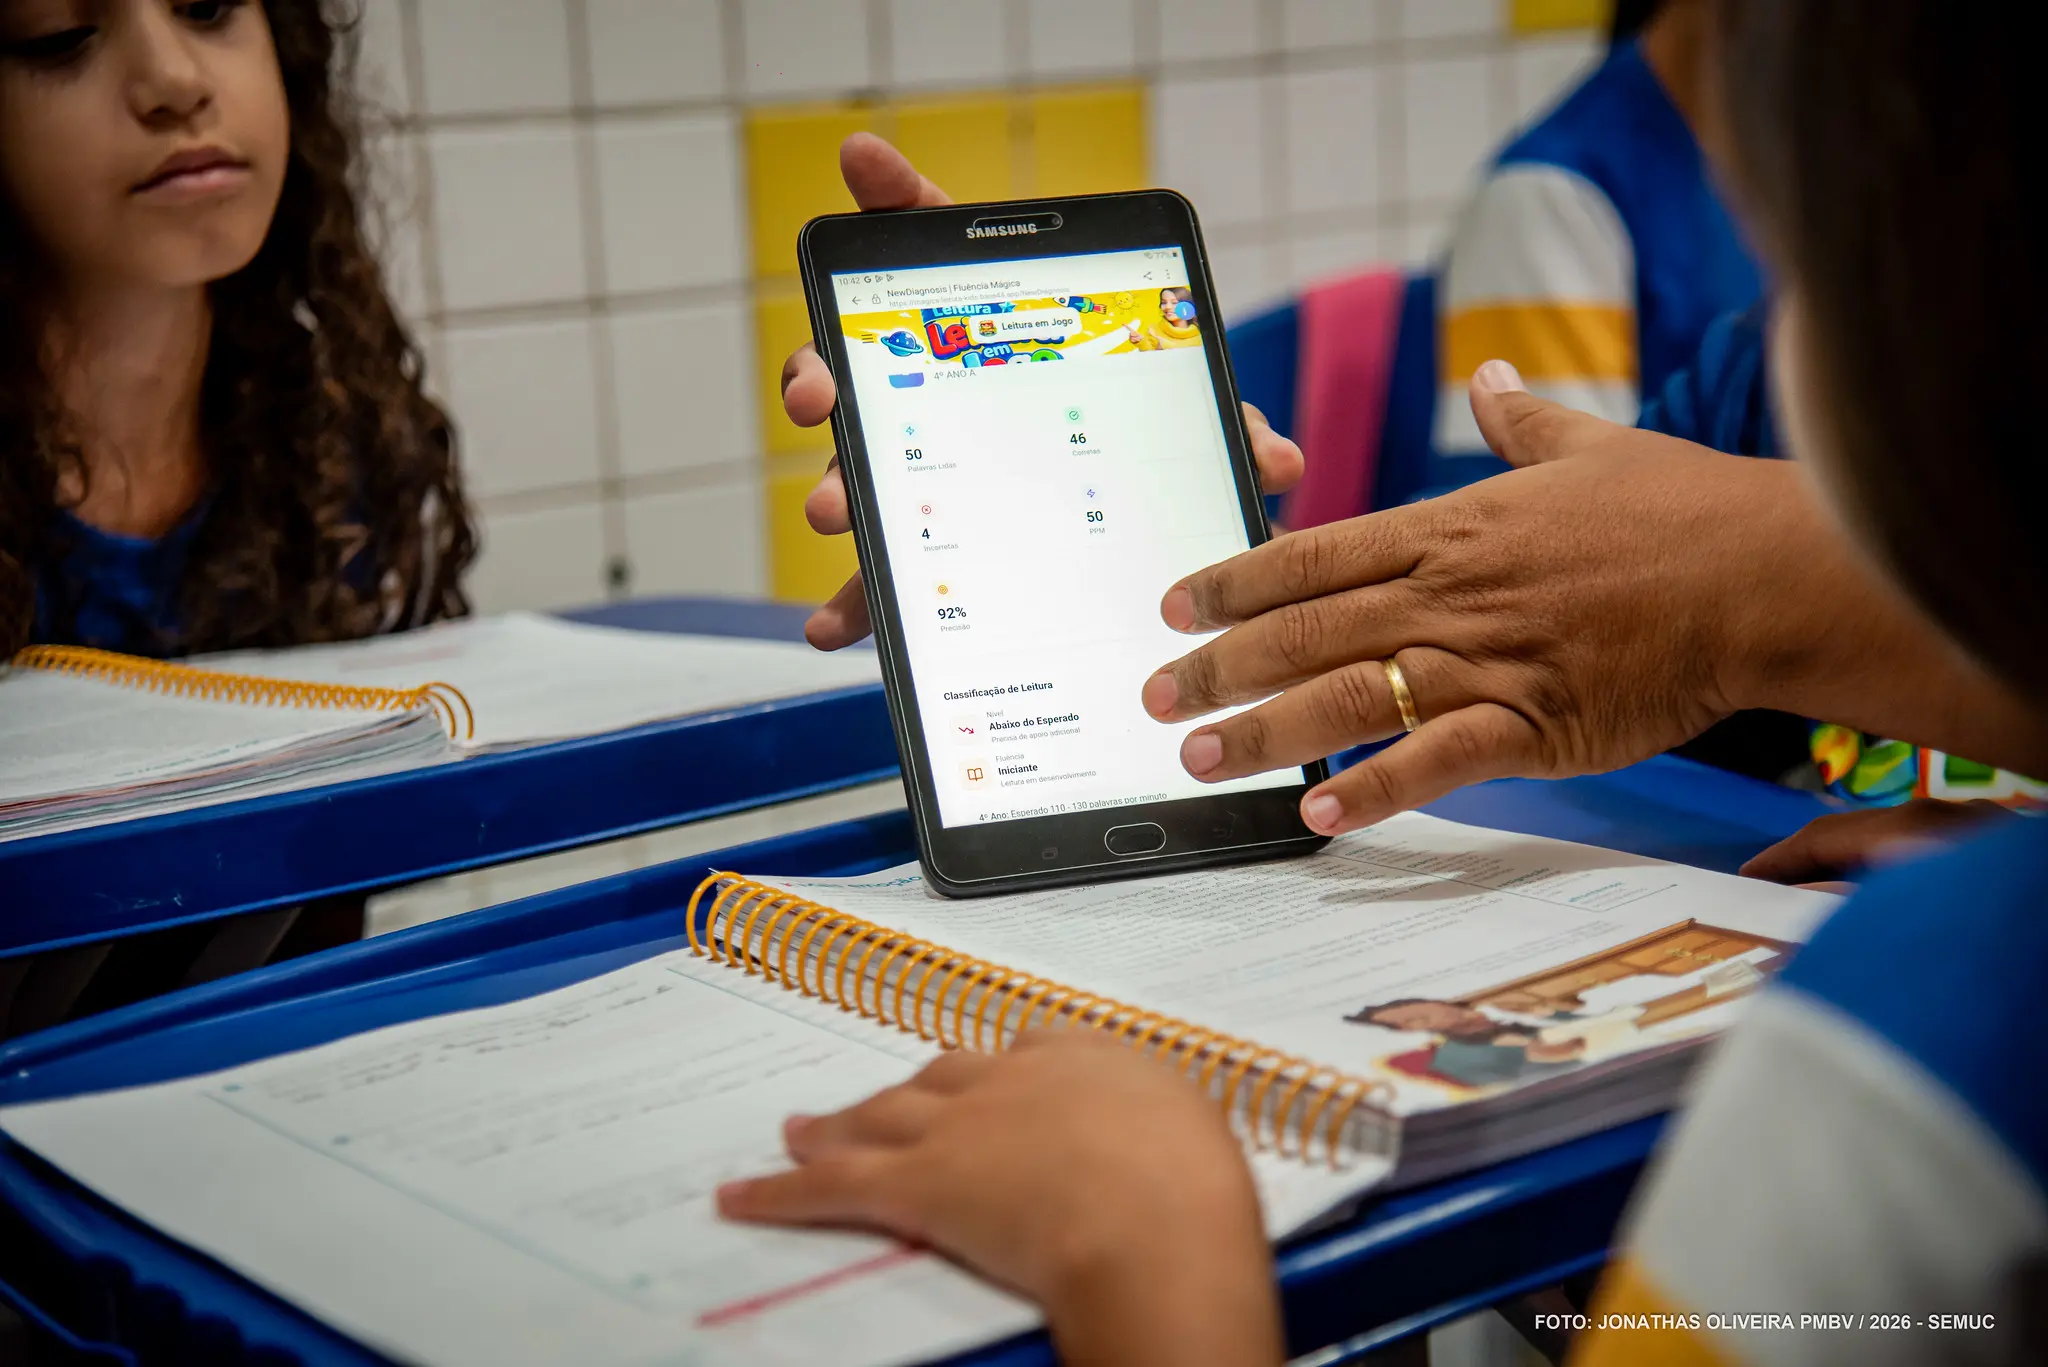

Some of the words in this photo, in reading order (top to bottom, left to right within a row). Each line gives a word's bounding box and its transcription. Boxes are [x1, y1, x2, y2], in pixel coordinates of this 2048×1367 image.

[966, 223, 1038, 239] SAMSUNG
[839, 276, 861, 286] 10:42
[887, 285, 947, 298] NewDiagnosis
[953, 281, 989, 292] Fluência
[990, 279, 1021, 290] Mágica
[933, 303, 992, 317] Leitura
[1001, 320, 1033, 331] Leitura
[1035, 320, 1049, 328] em
[1051, 318, 1074, 328] Jogo
[983, 343, 1011, 358] em
[946, 369, 967, 380] ANO
[969, 368, 977, 377] A
[1069, 433, 1087, 444] 46
[905, 448, 922, 460] 50
[1072, 447, 1101, 457] Corretas
[907, 463, 937, 473] Palavras
[938, 462, 957, 470] Lidas
[1086, 510, 1104, 522] 50
[921, 528, 931, 539] 4
[1089, 527, 1106, 535] PPM
[923, 543, 959, 552] Incorretas
[937, 606, 967, 620] 92%
[940, 623, 971, 632] Precisão
[943, 686, 1006, 701] Classificação
[1007, 684, 1019, 694] de
[1020, 681, 1054, 693] Leitura
[989, 719, 1021, 731] Abaixo
[1023, 717, 1035, 727] do
[1036, 713, 1080, 726] Esperado
[991, 734, 1018, 743] Precisa
[1018, 732, 1028, 740] de
[1029, 730, 1049, 740] apoio
[1049, 726, 1081, 737] adicional
[995, 753, 1025, 763] Fluência
[998, 763, 1039, 776] Iniciante
[1000, 778, 1025, 788] Leitura
[1025, 777, 1037, 785] em
[1038, 769, 1097, 783] desenvolvimento
[979, 813, 989, 822] 4º
[990, 811, 1010, 820] Ano:
[1010, 807, 1049, 819] Esperado
[1050, 804, 1066, 813] 110
[1072, 801, 1088, 810] 130
[1089, 798, 1123, 809] palavras
[1124, 796, 1138, 804] por
[1139, 792, 1168, 802] minuto
